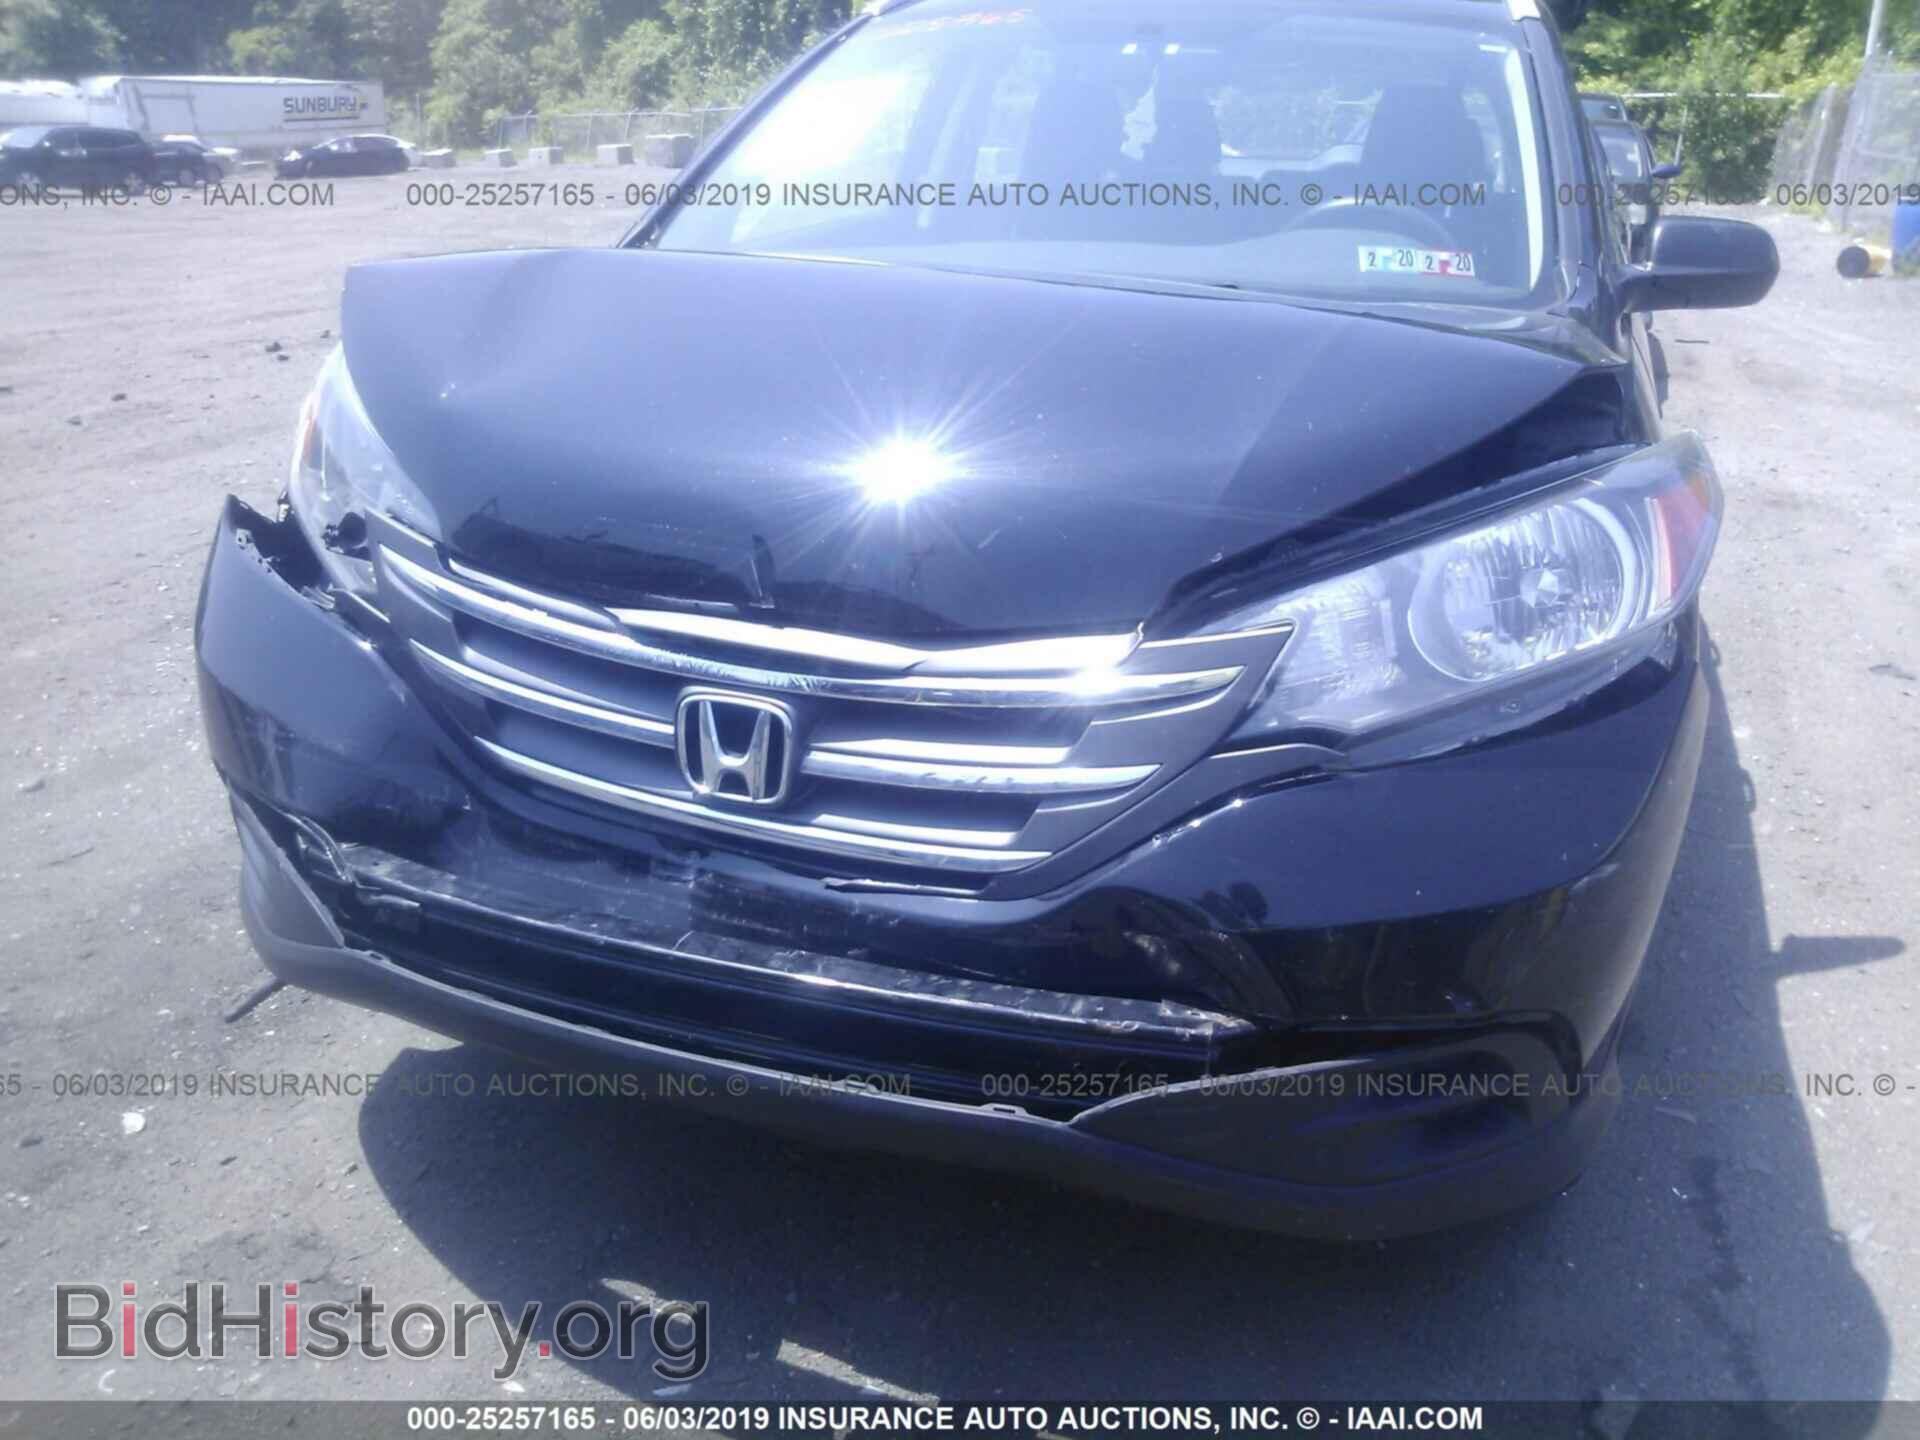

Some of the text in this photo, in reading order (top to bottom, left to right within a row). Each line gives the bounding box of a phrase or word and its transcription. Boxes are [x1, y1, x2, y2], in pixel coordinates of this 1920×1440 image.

[283, 96, 357, 113] SUNBURY
[1368, 249, 1413, 267] 2 20
[1425, 254, 1471, 271] 2 20
[698, 700, 771, 800] H
